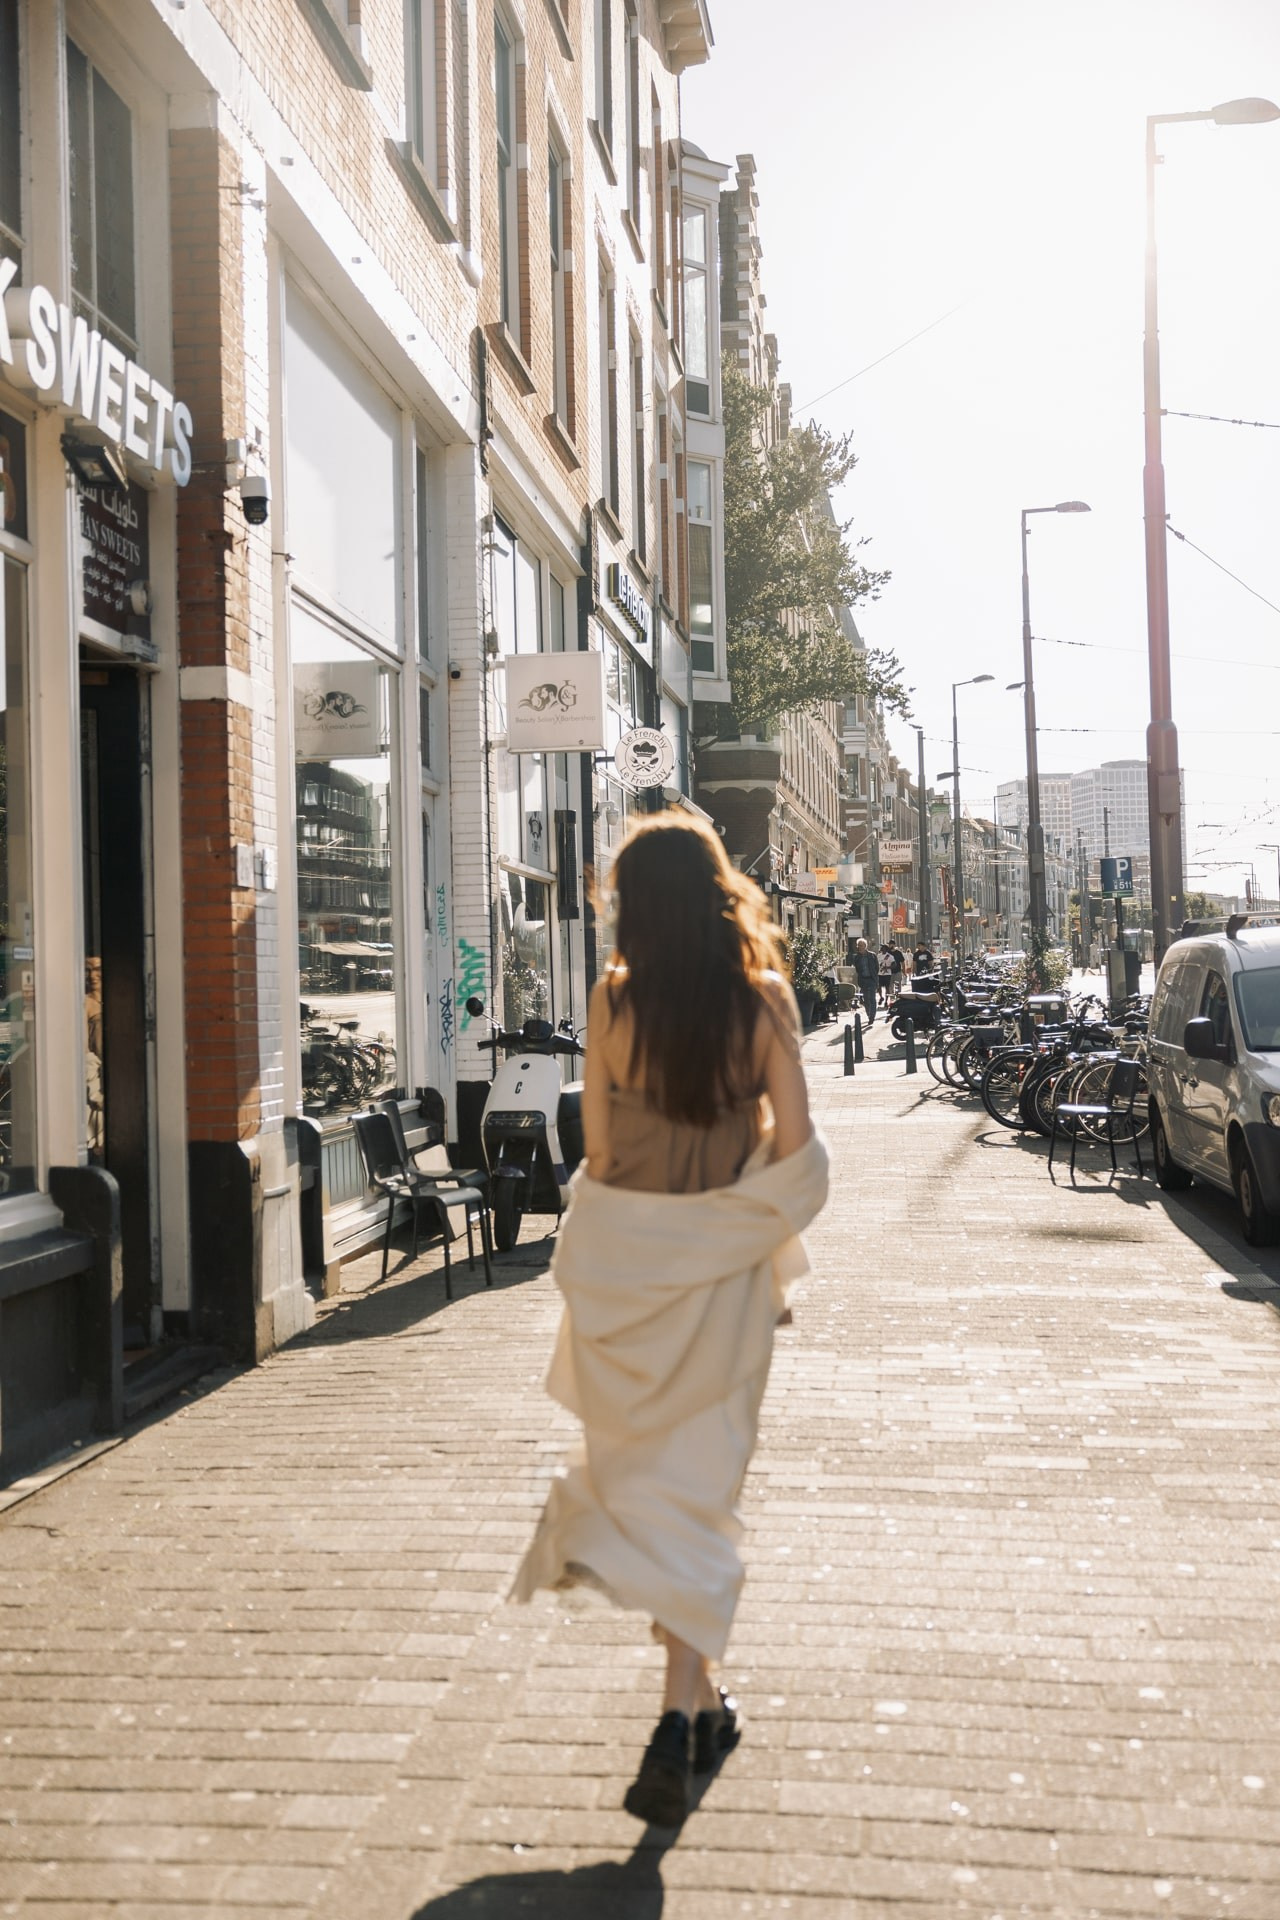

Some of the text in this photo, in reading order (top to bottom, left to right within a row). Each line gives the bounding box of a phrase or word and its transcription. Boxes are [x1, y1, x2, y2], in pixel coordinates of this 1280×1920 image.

[26, 285, 193, 487] SWEETS
[100, 524, 140, 566] SWEETS
[515, 716, 536, 724] Beauty
[621, 730, 668, 749] Le Frenchy
[620, 766, 667, 785] Le Frenchy
[1116, 858, 1129, 878] P
[1119, 881, 1132, 890] 511
